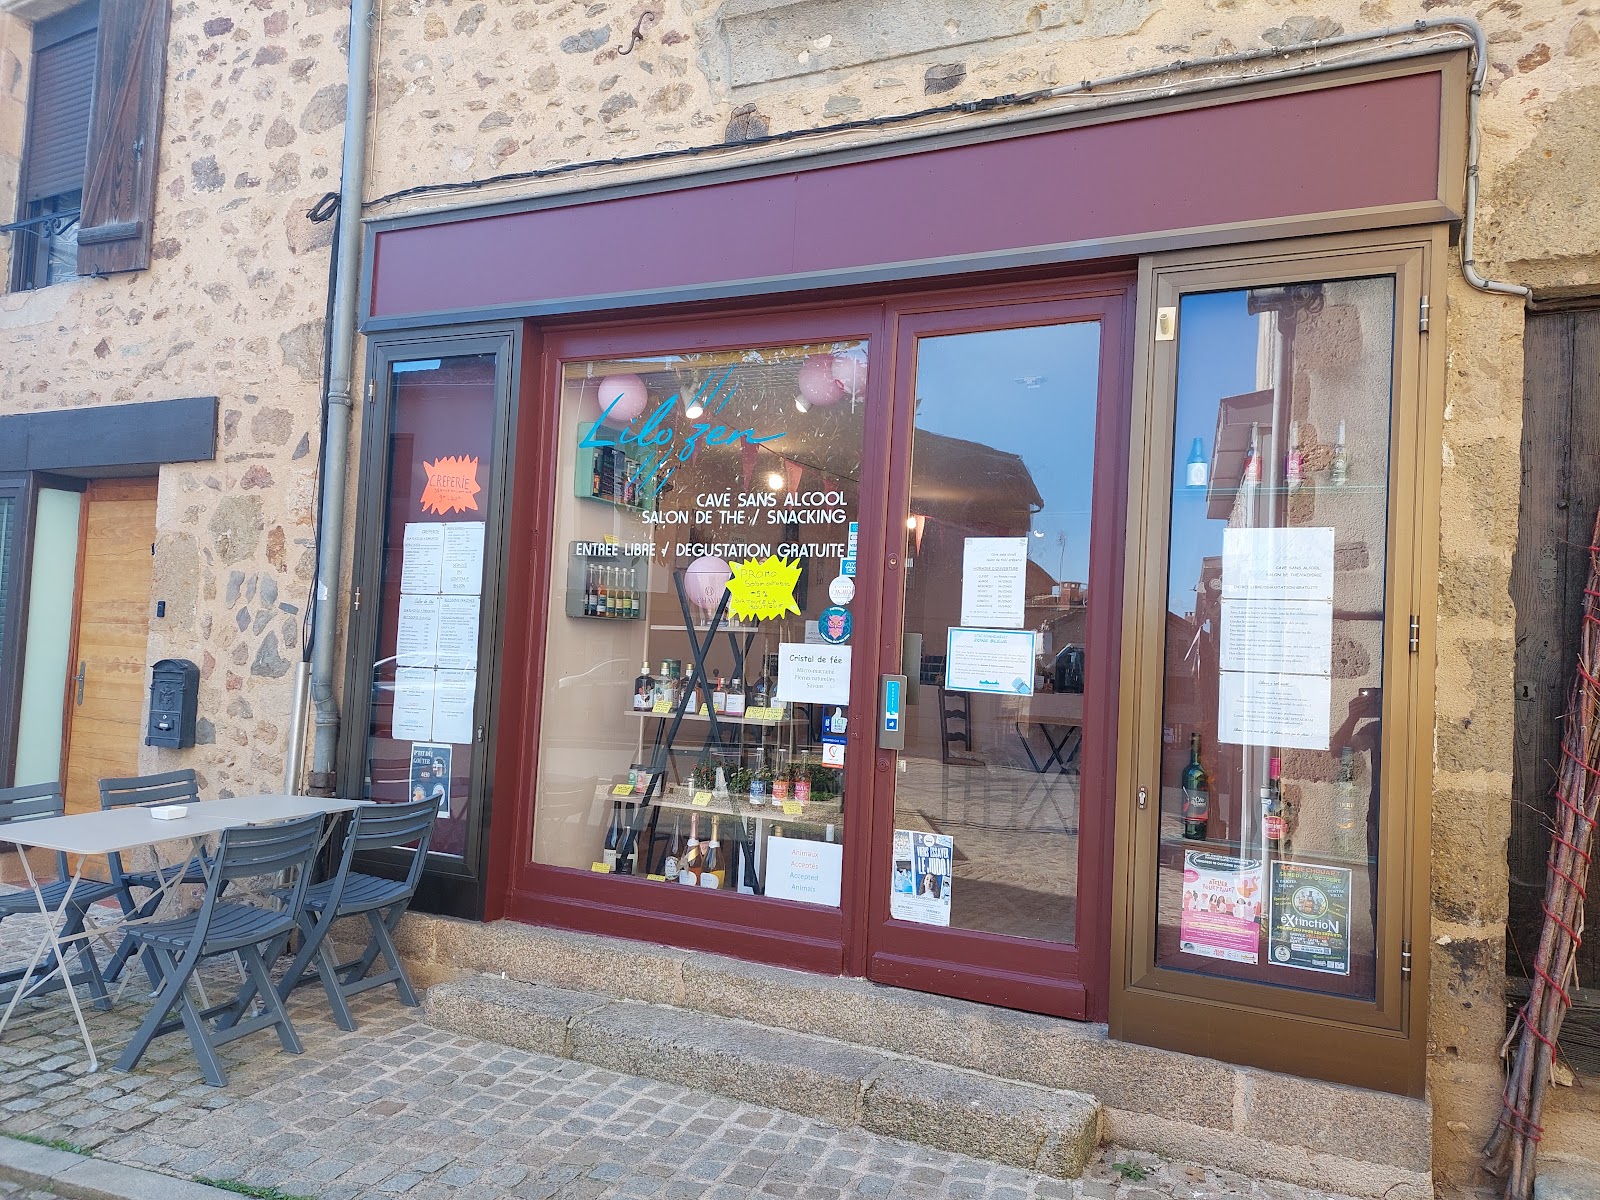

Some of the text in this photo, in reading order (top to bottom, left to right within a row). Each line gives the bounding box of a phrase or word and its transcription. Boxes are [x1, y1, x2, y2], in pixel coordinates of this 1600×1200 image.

[696, 491, 847, 508] CAVE SANS ALCOOL
[642, 510, 689, 524] SALON
[696, 510, 713, 524] DE
[720, 510, 745, 524] THE
[767, 509, 847, 524] SNACKING
[576, 543, 619, 556] ENTREE
[624, 543, 656, 557] LIBRE
[675, 543, 771, 558] DEGUSTATION
[777, 543, 845, 558] GRATUITE
[789, 654, 814, 662] Cristal
[817, 655, 827, 664] de
